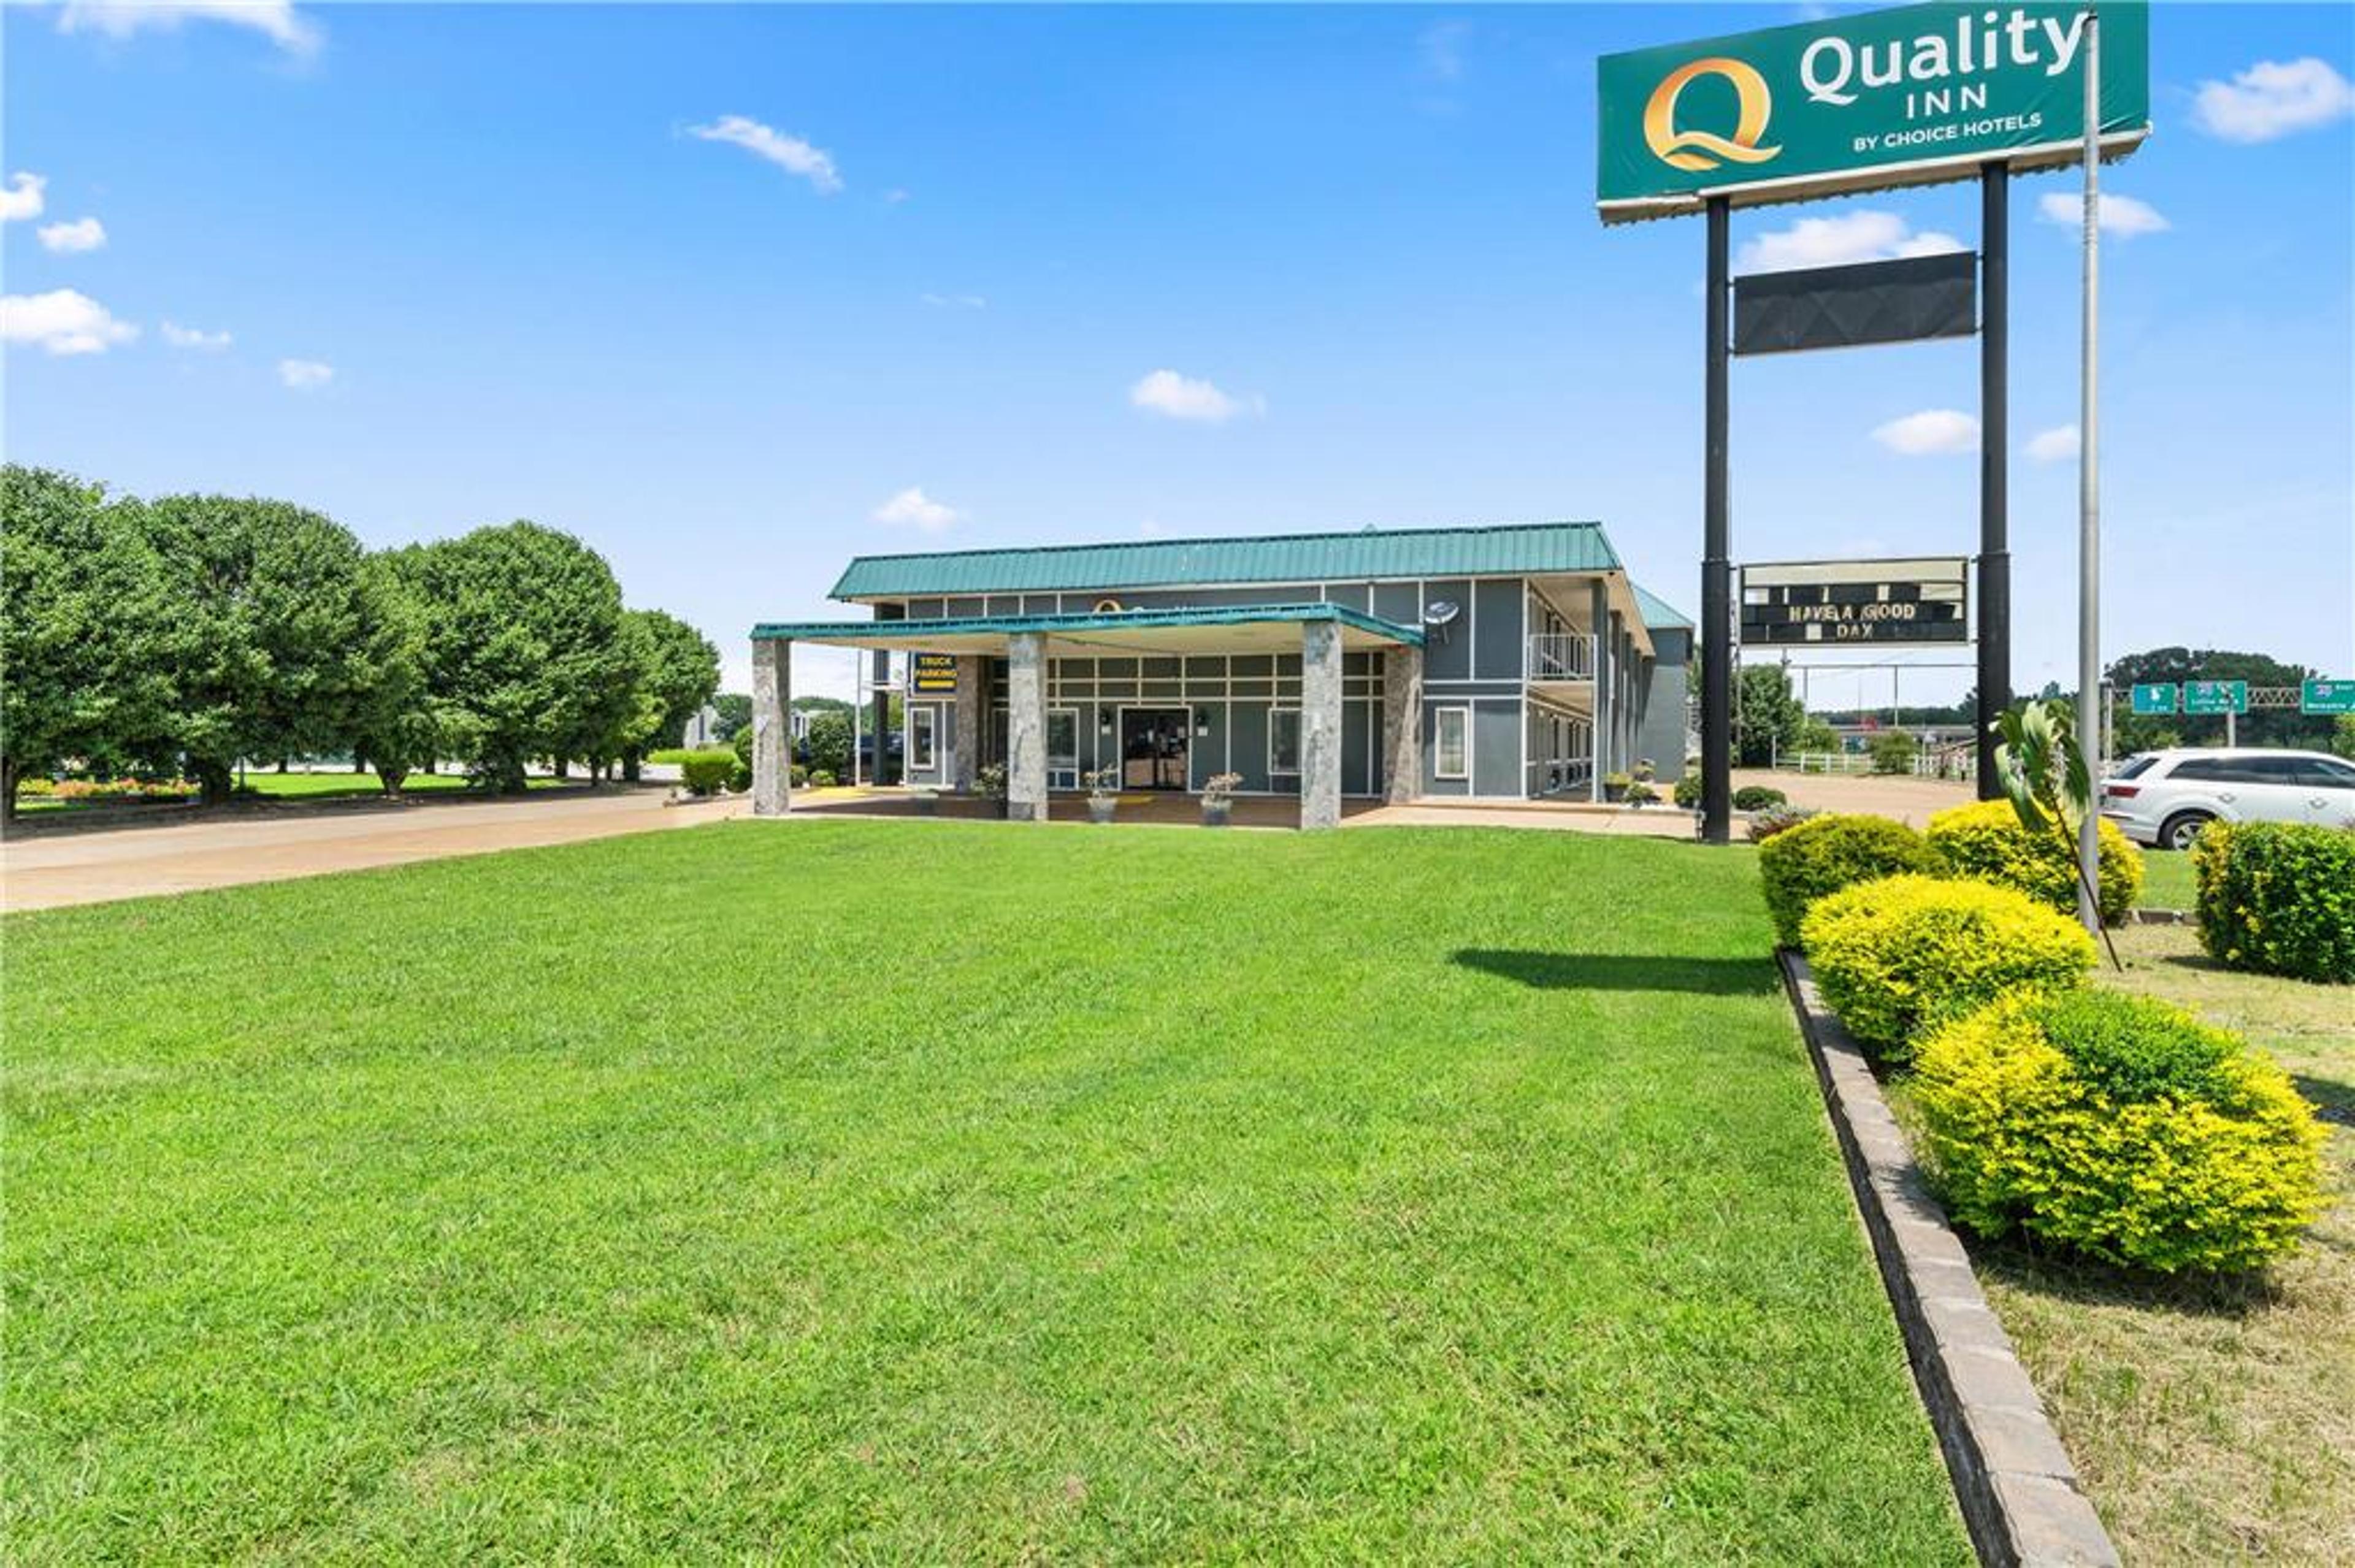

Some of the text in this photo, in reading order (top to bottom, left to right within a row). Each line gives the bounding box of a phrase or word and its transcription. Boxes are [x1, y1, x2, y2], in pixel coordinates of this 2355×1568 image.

[1800, 9, 2088, 105] Quality
[1907, 83, 1986, 120] INN
[1853, 112, 2042, 152] BY CHOICE HOTELS
[1789, 604, 1915, 621] HAVE A GOOD
[1837, 623, 1873, 639] DAY
[920, 657, 952, 667] TRUCK
[915, 669, 957, 679] PARKING
